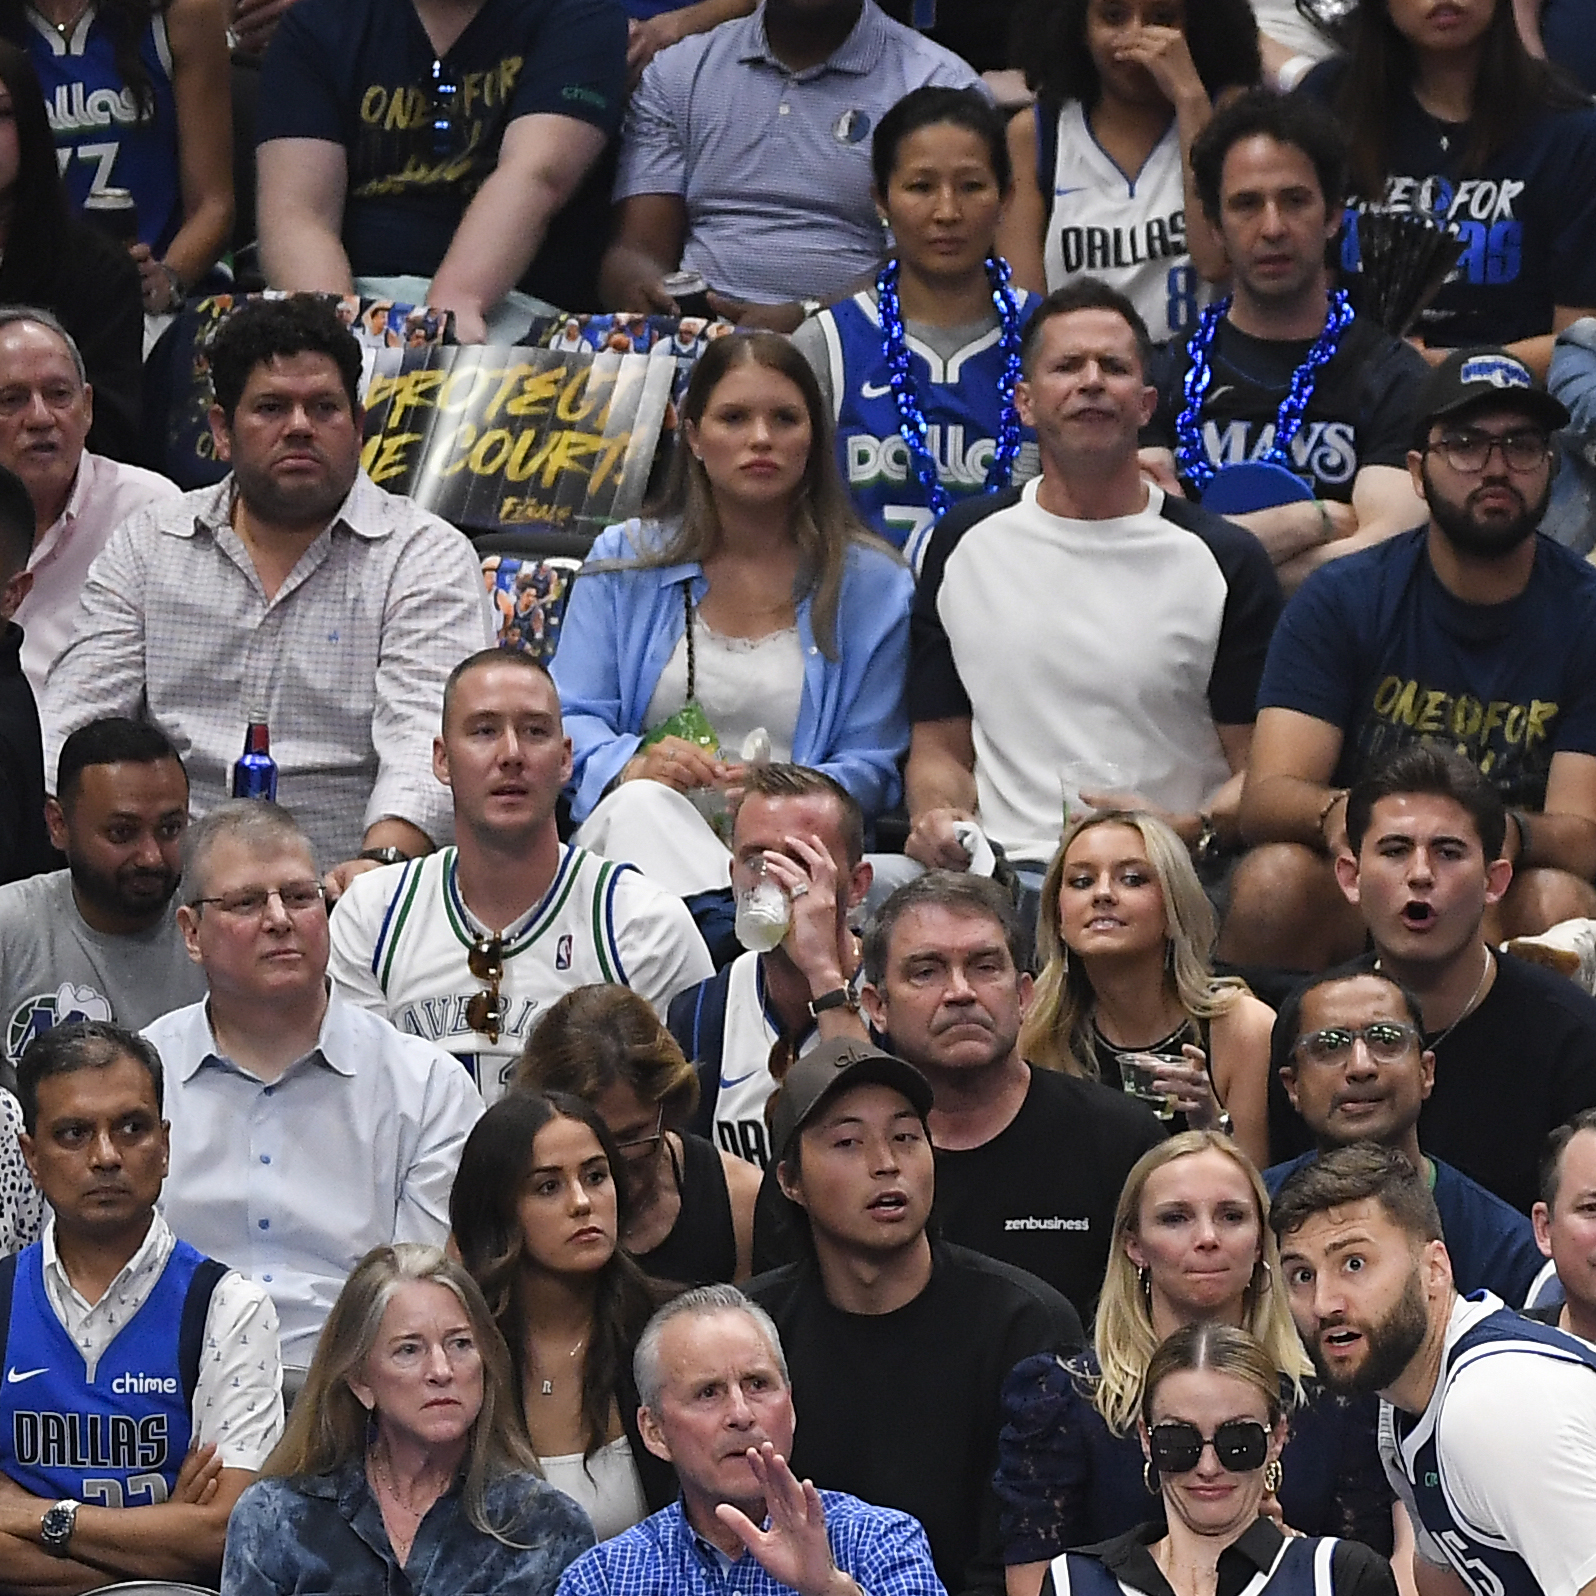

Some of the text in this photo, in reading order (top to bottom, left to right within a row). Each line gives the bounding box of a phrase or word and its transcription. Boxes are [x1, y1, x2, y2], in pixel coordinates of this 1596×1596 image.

[1447, 176, 1525, 219] FOR
[1485, 698, 1559, 740] FOR
[1004, 1216, 1090, 1232] zenbusiness
[111, 1371, 177, 1395] chime
[14, 1413, 169, 1469] DALLAS
